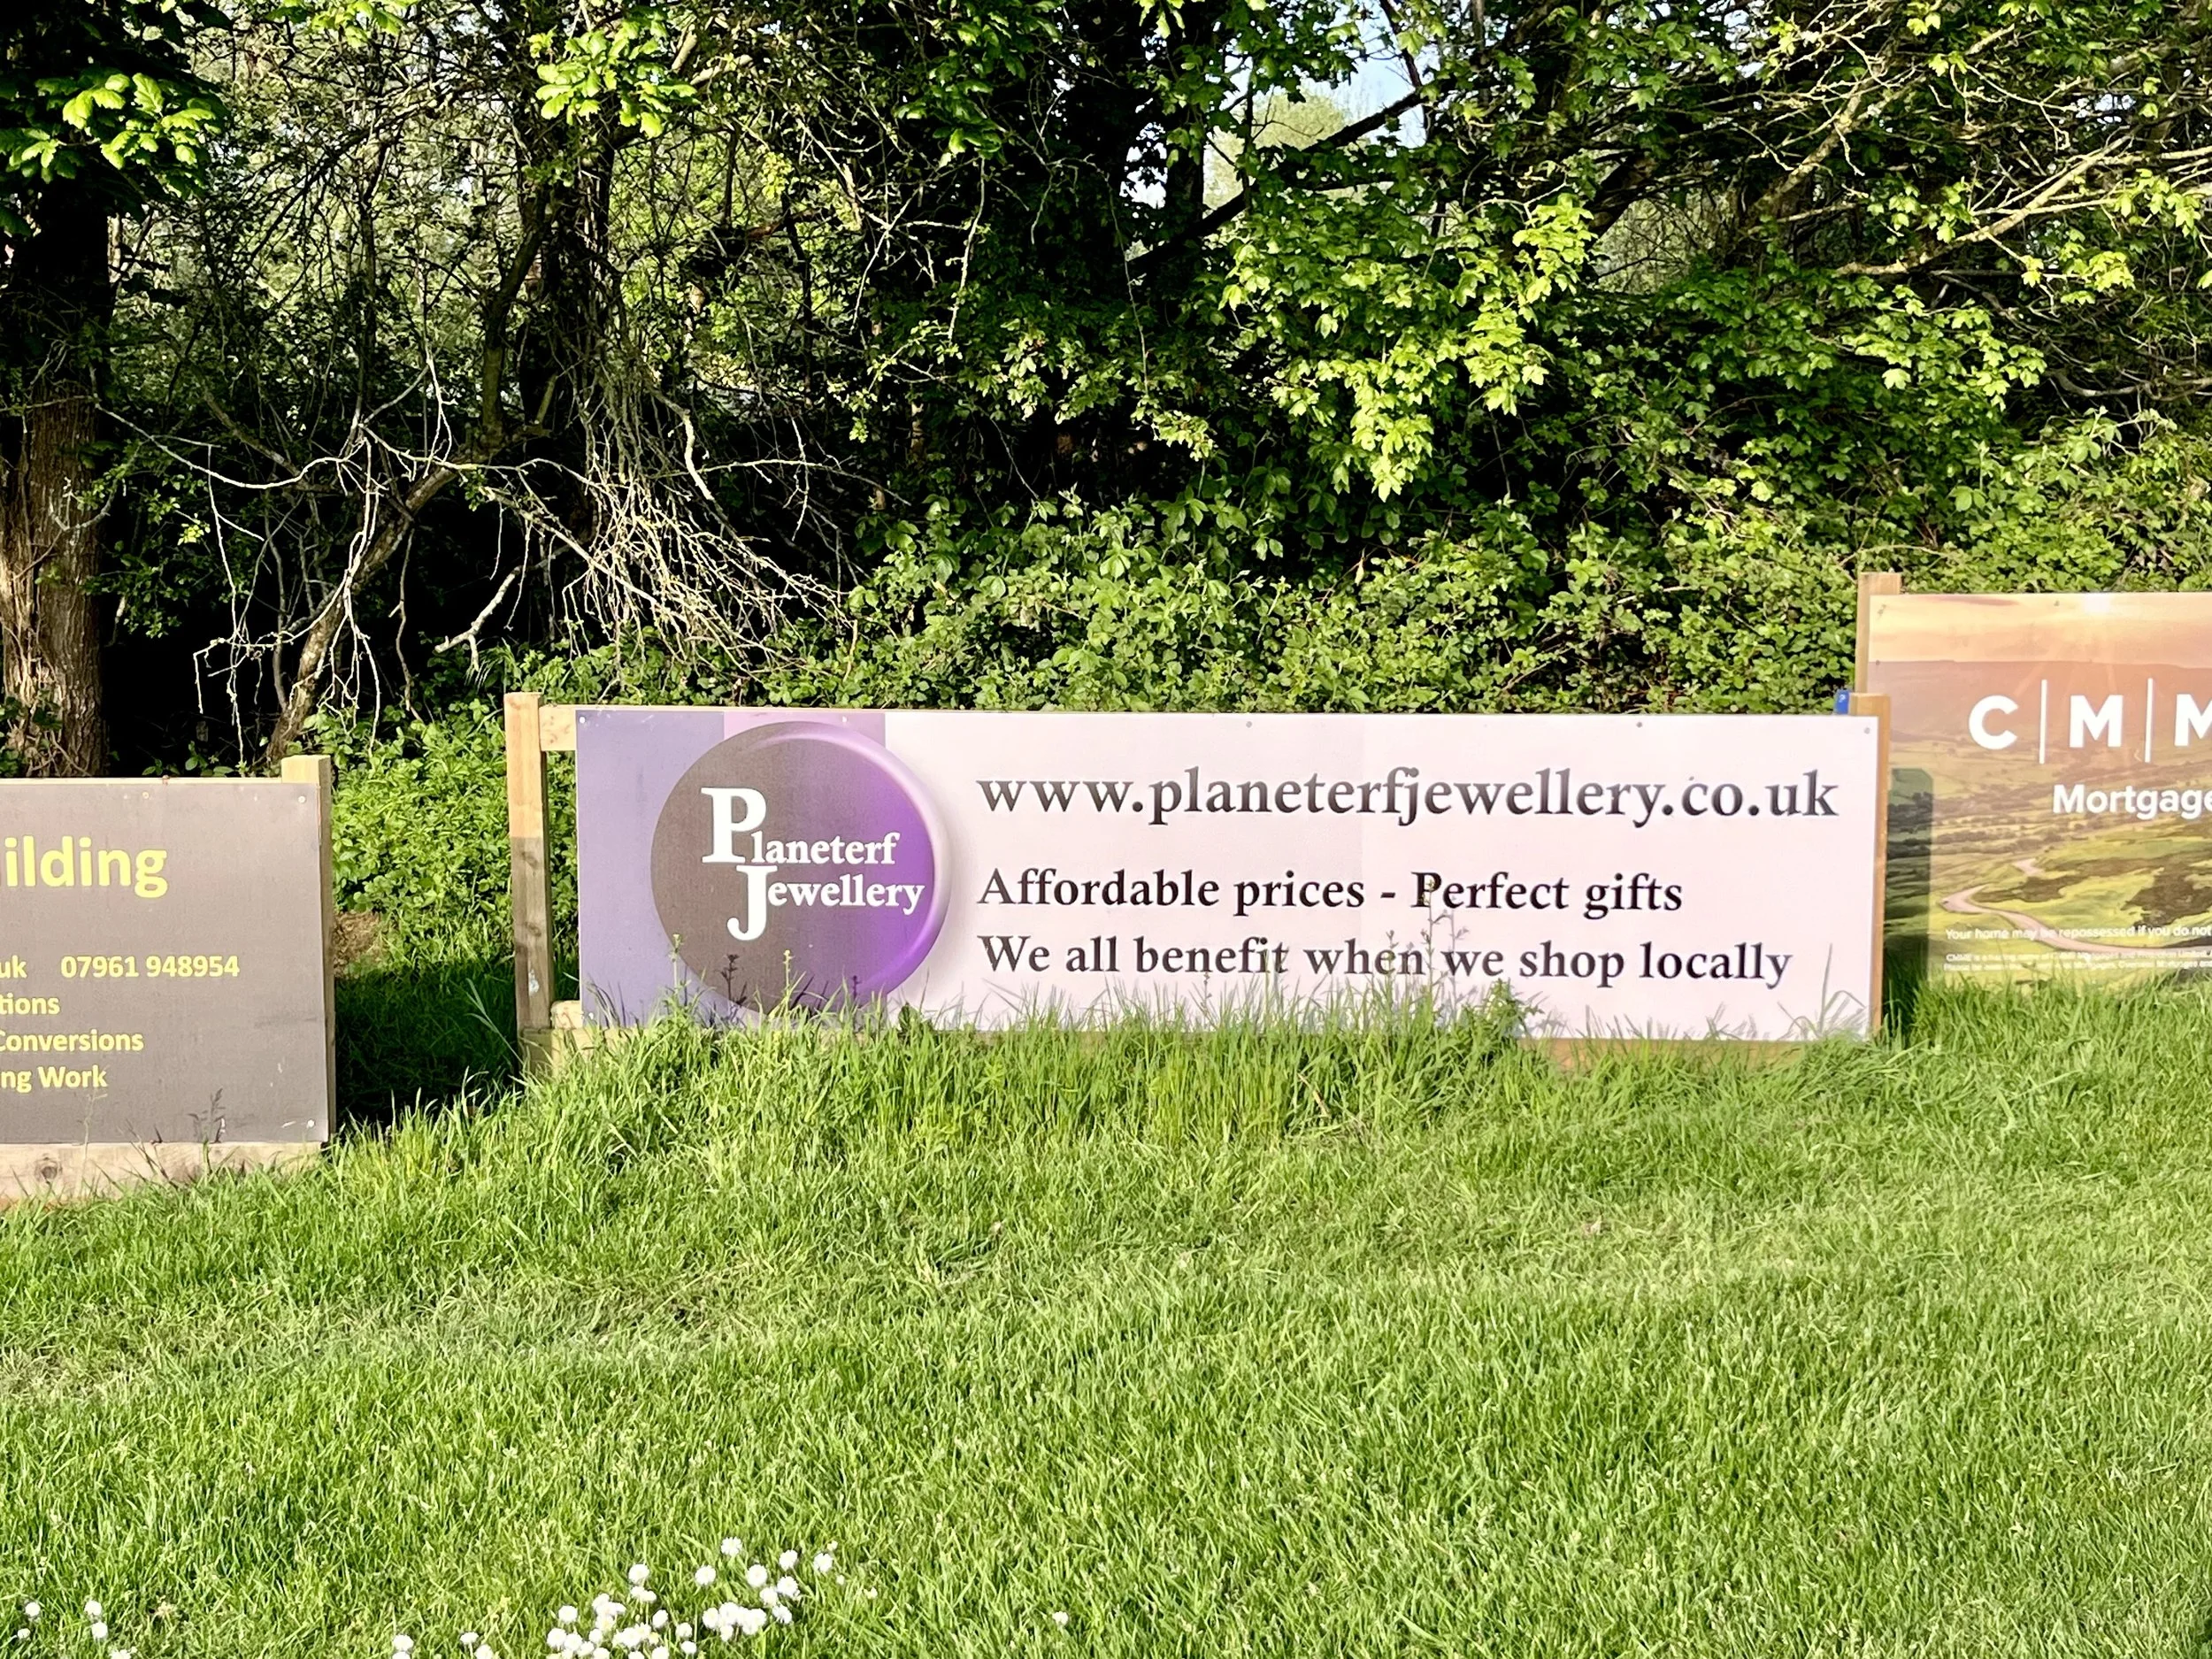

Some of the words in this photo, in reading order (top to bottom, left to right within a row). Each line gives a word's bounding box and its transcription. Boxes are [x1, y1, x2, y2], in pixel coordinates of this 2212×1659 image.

[977, 766, 1838, 826] www.planeterfjewellery.co.uk
[701, 787, 900, 864] Planeterf
[4, 835, 168, 898] ilding
[727, 865, 925, 941] Jewellery
[978, 868, 1219, 908] Affordable
[1233, 871, 1364, 917] prices
[1411, 872, 1569, 910] Perfect
[1583, 872, 1682, 919] gifts
[1946, 929, 1971, 940] Your
[1975, 928, 2009, 940] home
[2012, 929, 2039, 941] may
[2059, 926, 2135, 939] repossessed
[2138, 926, 2147, 936] if
[2148, 928, 2170, 939] you
[2173, 926, 2190, 936] do
[2192, 926, 2212, 936] not
[0, 955, 27, 979] uk
[60, 956, 140, 978] 07961
[146, 956, 240, 978] 948954
[978, 935, 1049, 972] We
[1065, 935, 1118, 972] all
[1133, 936, 1288, 974] benefit
[1303, 937, 1424, 975] when
[1440, 949, 1503, 976] we
[1519, 941, 1624, 987] shop
[1639, 941, 1793, 988] locally
[37, 1064, 108, 1087] Work
